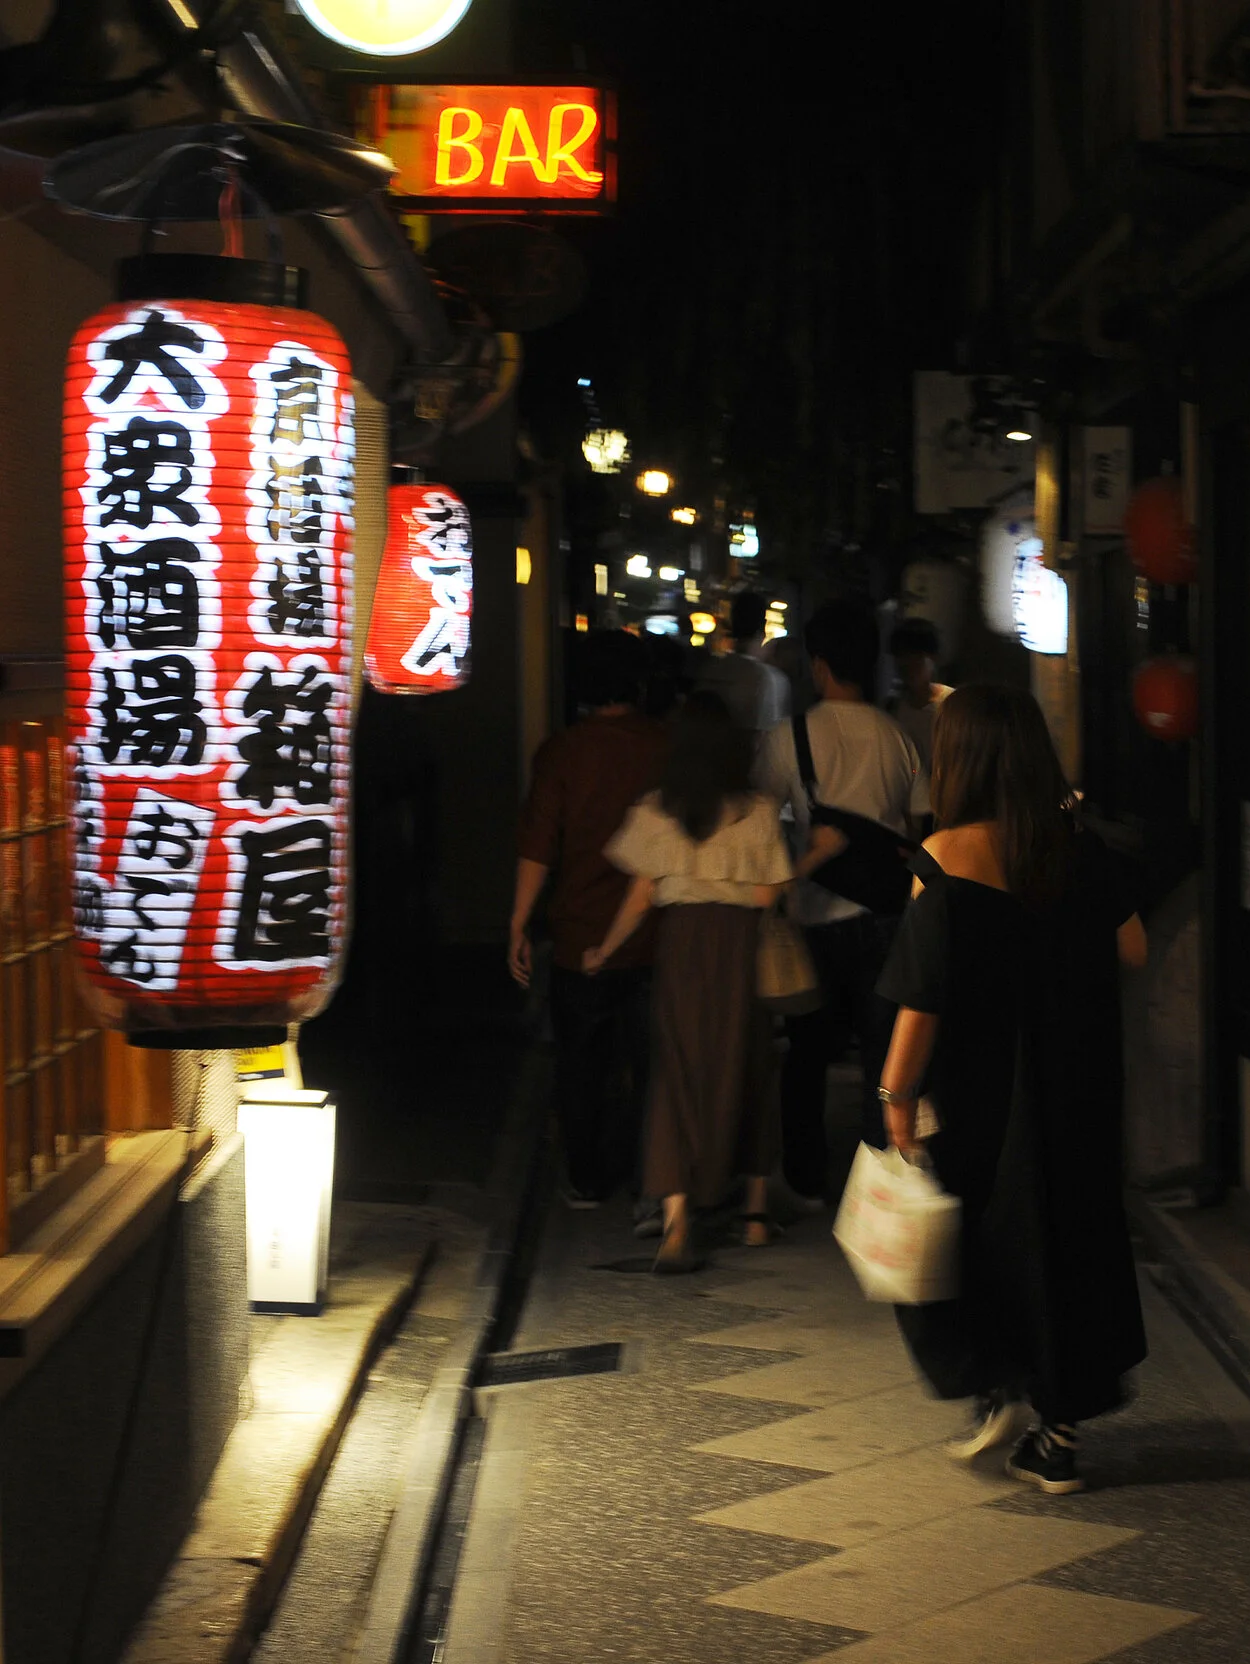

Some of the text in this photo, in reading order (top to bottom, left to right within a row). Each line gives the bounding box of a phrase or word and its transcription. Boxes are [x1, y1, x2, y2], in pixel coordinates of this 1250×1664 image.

[435, 103, 603, 186] BAR
[97, 310, 208, 766] 大衆酒場
